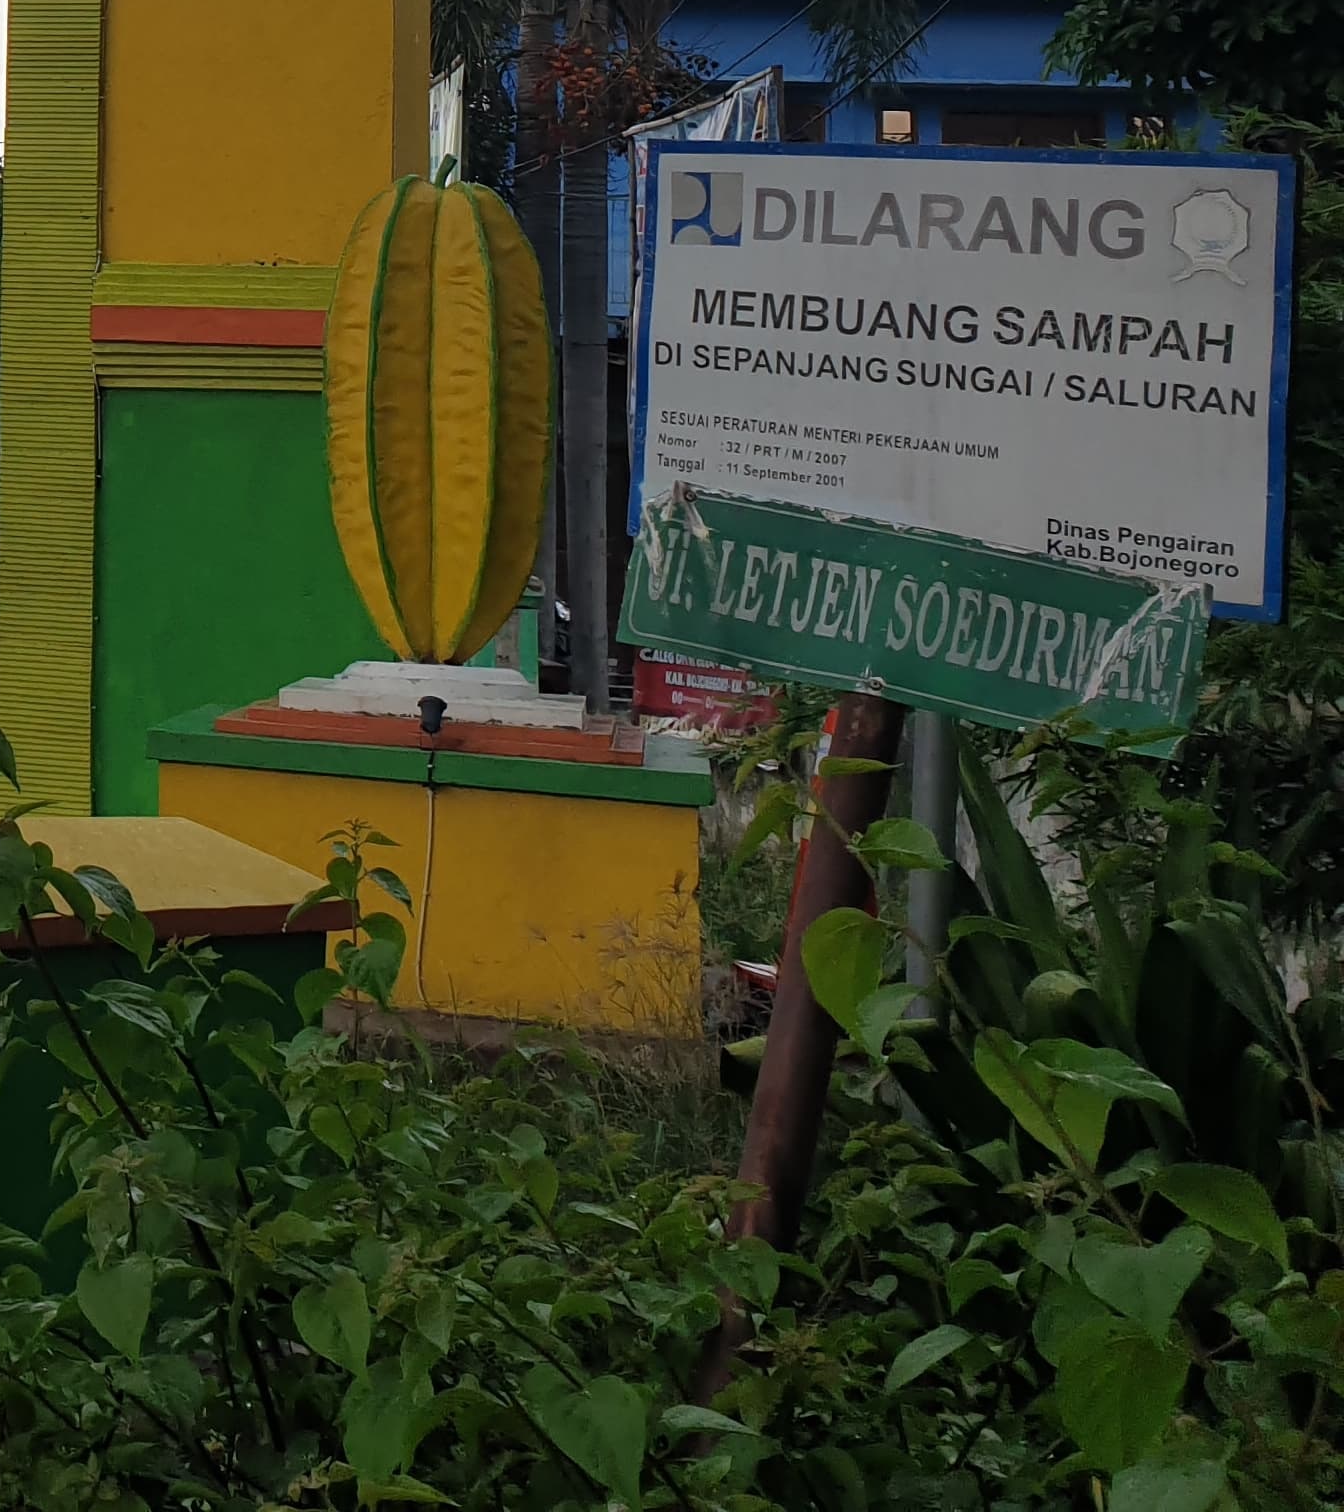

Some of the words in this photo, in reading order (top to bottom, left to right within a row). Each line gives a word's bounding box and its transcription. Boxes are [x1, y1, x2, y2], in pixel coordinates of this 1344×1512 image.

[752, 187, 1146, 260] DILARANG
[691, 288, 979, 344] MEMBUANG
[992, 306, 1234, 364] SAMPAH
[655, 341, 682, 366] DI
[692, 344, 888, 384] SEPANJANG
[896, 361, 1033, 397] SUNGAI
[1043, 372, 1056, 397] /
[1064, 375, 1257, 418] SALURAN
[657, 433, 698, 449] Nomor
[753, 444, 780, 458] PRT
[792, 448, 804, 461] M
[815, 452, 847, 466] 2007
[661, 410, 709, 428] SESUAI
[713, 416, 798, 437] PERATURAN
[803, 426, 862, 445] MENTERI
[866, 433, 950, 453] PEKERJAAN
[954, 442, 999, 460] UMUM
[657, 453, 705, 473] Tanggal
[743, 464, 812, 486] September
[815, 473, 845, 487] 2001
[1047, 518, 1110, 542] Dinas
[1118, 527, 1234, 556] Pengairan
[710, 540, 882, 643] LETJEN
[886, 574, 1173, 704] SOEDIRMAN
